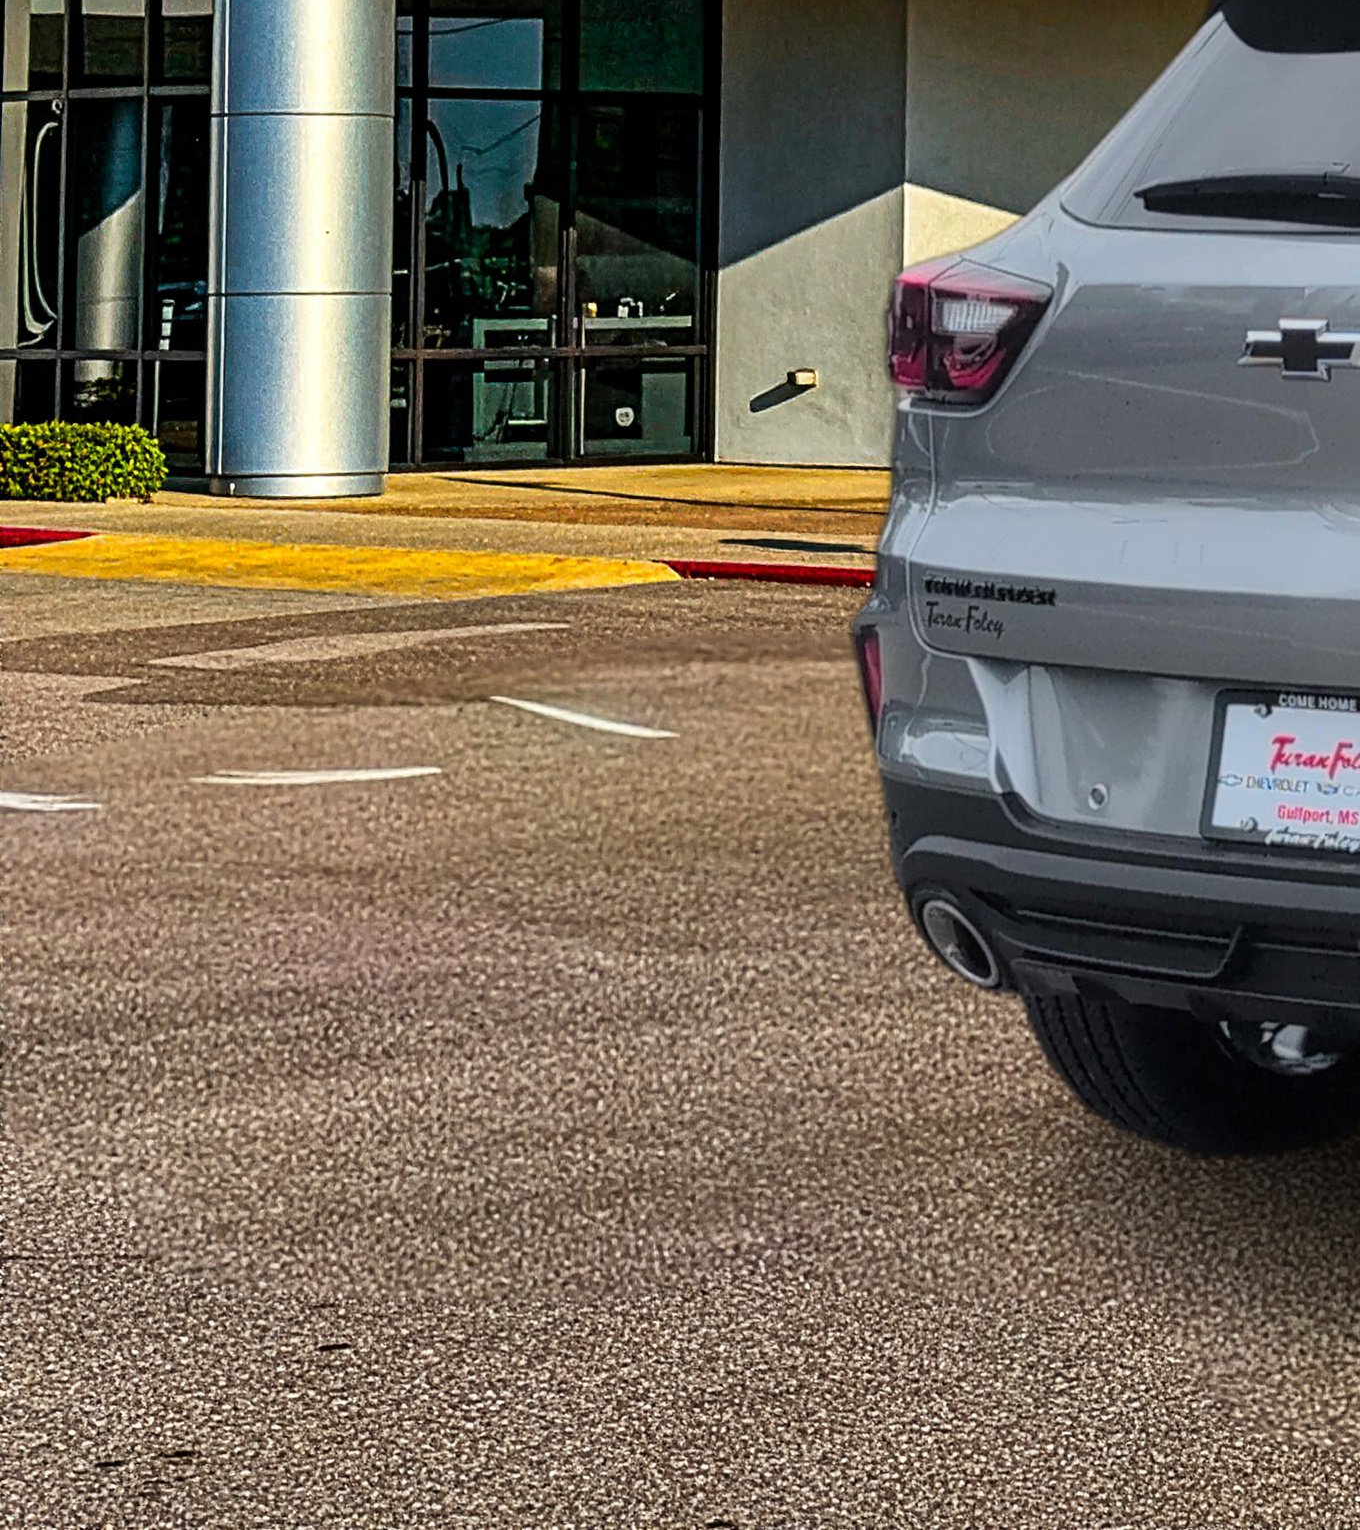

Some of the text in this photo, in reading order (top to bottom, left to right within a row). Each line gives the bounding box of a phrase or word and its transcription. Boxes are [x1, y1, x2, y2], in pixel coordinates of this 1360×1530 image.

[1278, 693, 1316, 709] COME
[1318, 696, 1357, 712] HOME
[1246, 775, 1309, 793] CHEVROLET
[1337, 810, 1360, 826] MS
